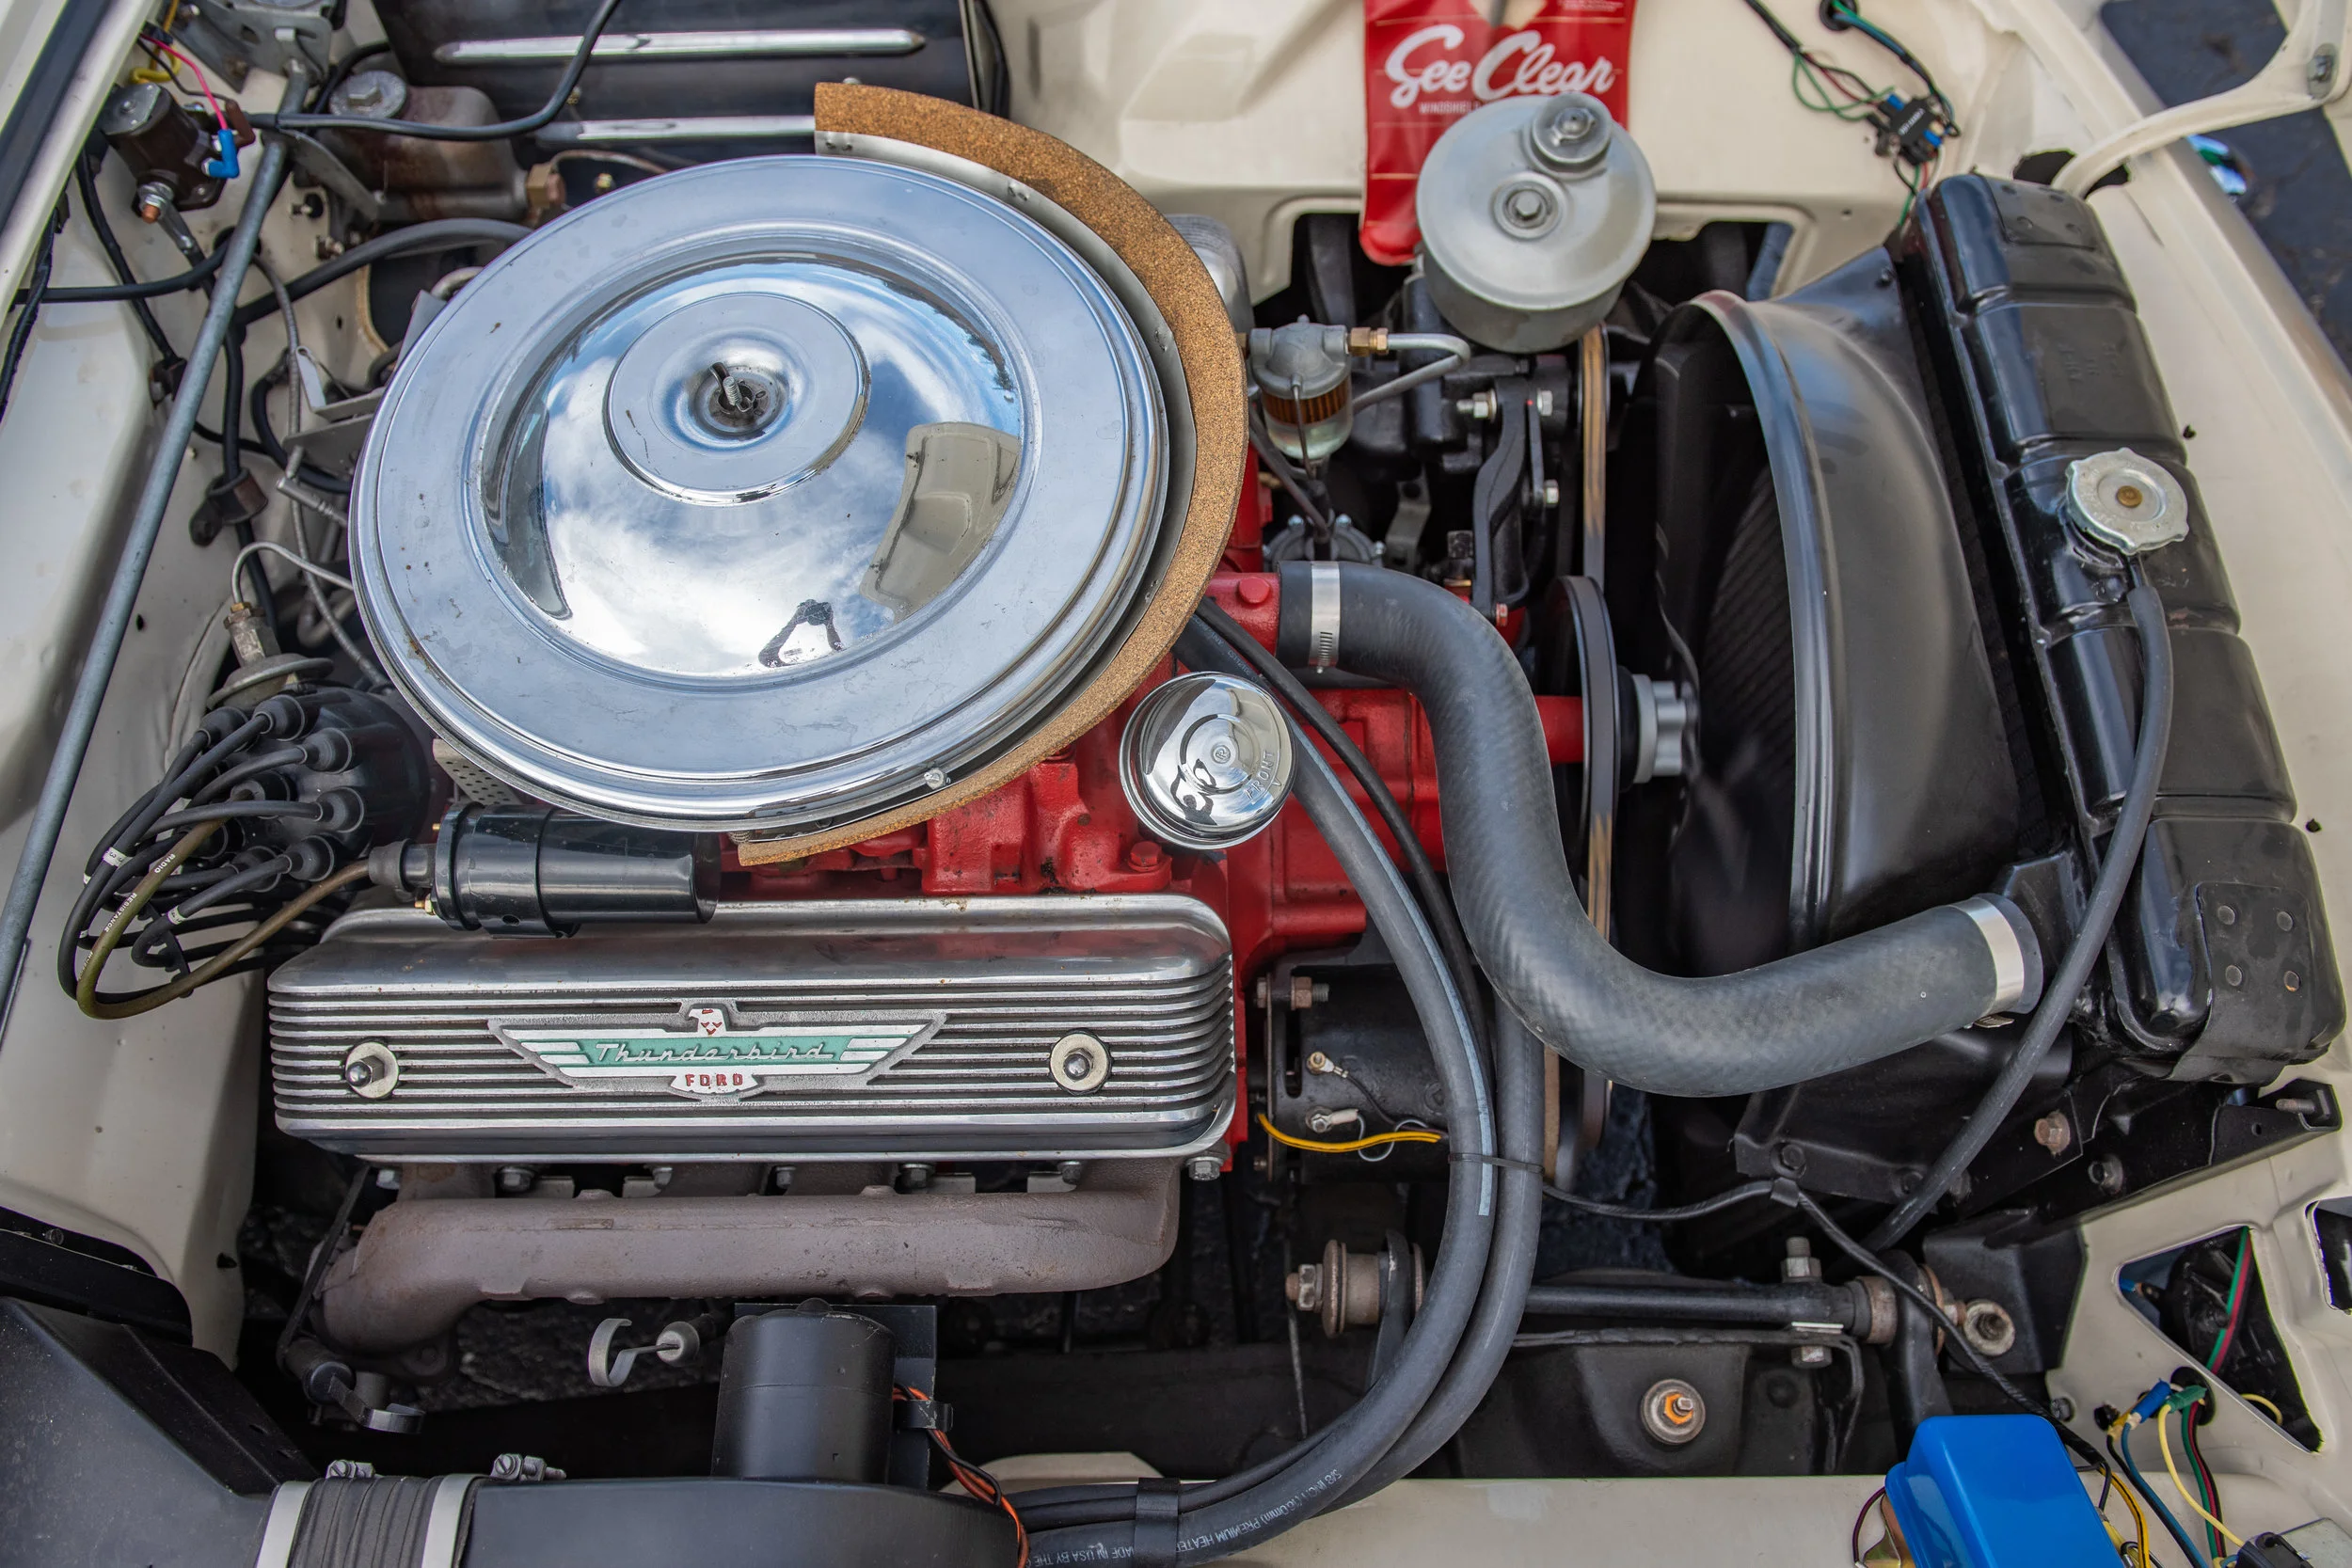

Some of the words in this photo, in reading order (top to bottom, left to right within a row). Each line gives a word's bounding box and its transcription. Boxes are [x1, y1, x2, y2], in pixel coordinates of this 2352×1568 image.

[1385, 24, 1471, 108] See
[1471, 30, 1615, 101] Clear
[1244, 751, 1274, 800] FRONT
[154, 853, 176, 873] RADIO
[104, 893, 137, 932] RESISTANCE
[596, 1042, 834, 1062] Thunderbird
[685, 1073, 743, 1086] FORD
[1325, 1469, 1343, 1485] 5/8
[1216, 1516, 1261, 1543] PREMIUM
[1034, 1554, 1054, 1567] THE
[1057, 1551, 1070, 1563] BY
[1072, 1549, 1094, 1561] USA
[1097, 1548, 1108, 1560] IN
